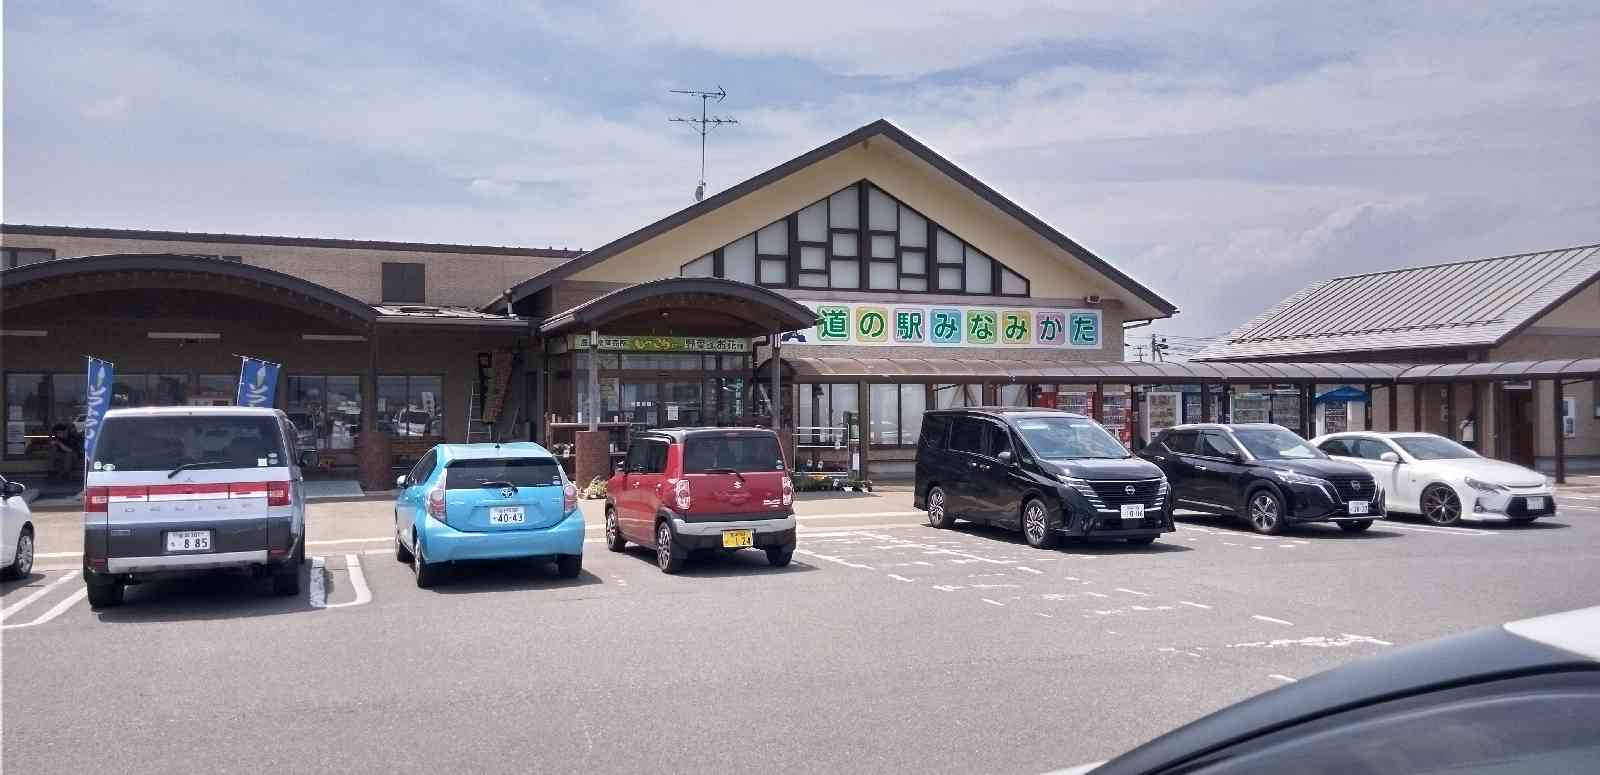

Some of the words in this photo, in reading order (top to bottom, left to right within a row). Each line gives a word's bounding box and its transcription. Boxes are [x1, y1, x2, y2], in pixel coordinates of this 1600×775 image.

[820, 309, 1094, 342] 道の駅みなみかた
